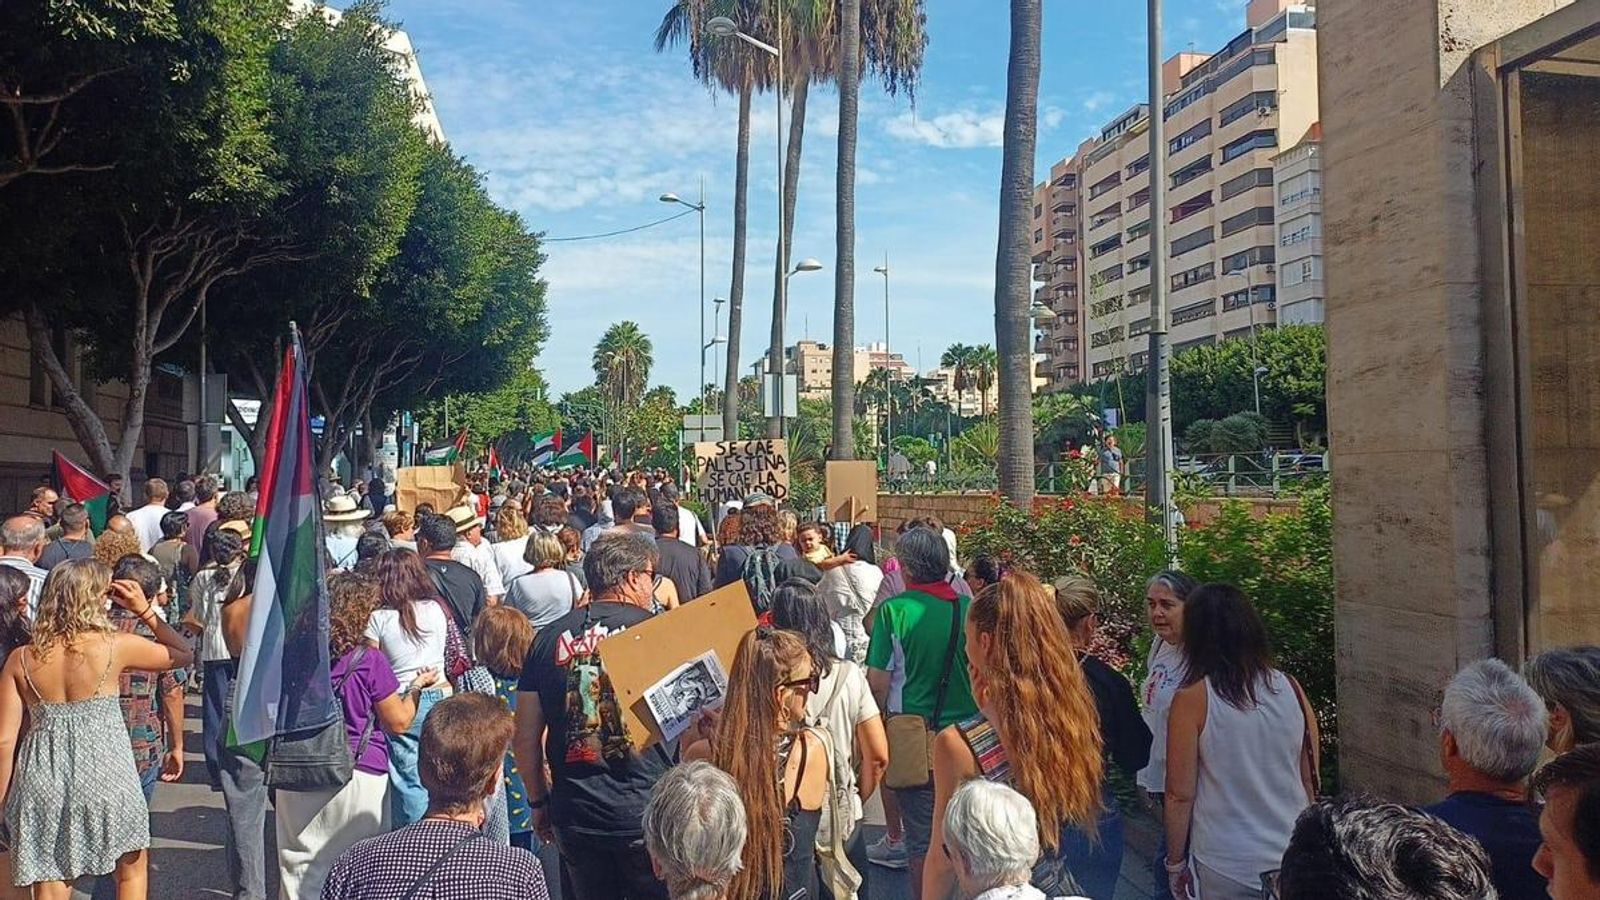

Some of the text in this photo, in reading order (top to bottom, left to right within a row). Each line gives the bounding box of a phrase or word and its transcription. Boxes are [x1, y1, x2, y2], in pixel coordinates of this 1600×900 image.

[715, 440, 775, 457] SE CAE
[708, 471, 778, 487] SE CAE LA
